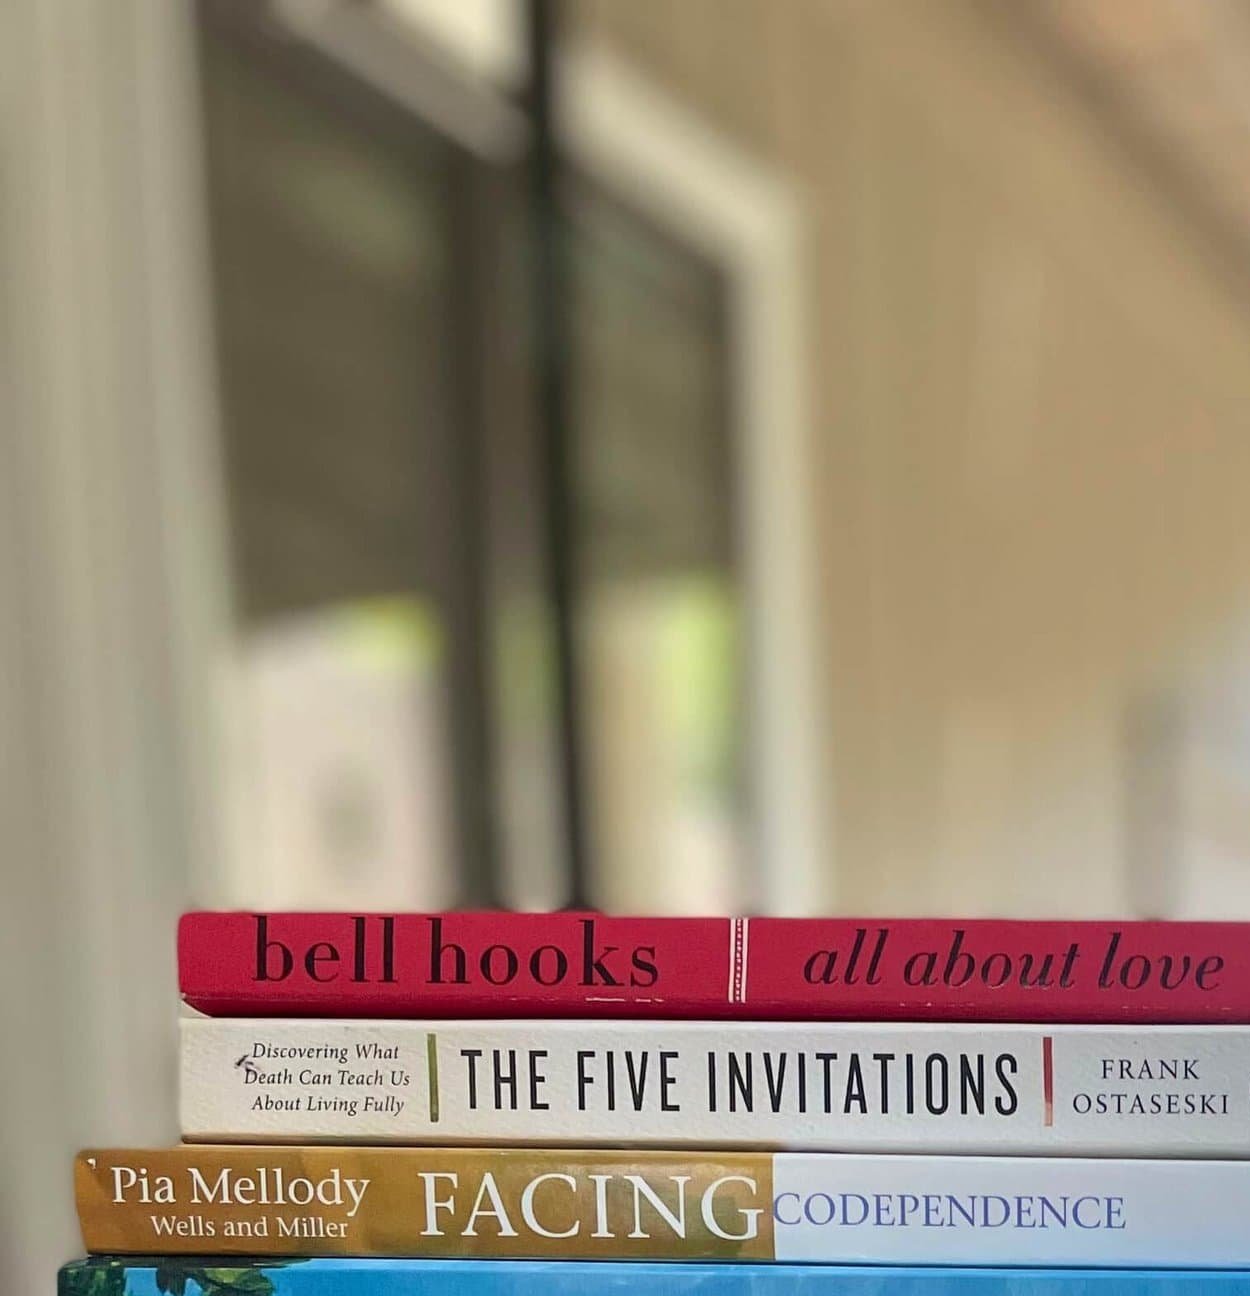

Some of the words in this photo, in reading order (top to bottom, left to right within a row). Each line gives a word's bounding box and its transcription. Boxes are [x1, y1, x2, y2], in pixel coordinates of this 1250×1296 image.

[252, 915, 397, 984] bell
[427, 918, 660, 988] hooks
[804, 929, 888, 987] all
[903, 931, 1081, 990] about
[1098, 931, 1224, 992] love
[252, 1043, 349, 1063] Discovering
[355, 1044, 399, 1060] What
[244, 1069, 293, 1086] Death
[300, 1070, 332, 1086] Can
[338, 1070, 384, 1086] Teach
[390, 1070, 410, 1087] Us
[1101, 1059, 1200, 1081] FRANK
[460, 1049, 550, 1111] THE
[577, 1050, 680, 1111] FIVE
[709, 1051, 1018, 1116] INVITATIONS
[252, 1095, 300, 1113] About
[306, 1096, 358, 1116] Living
[363, 1096, 405, 1117] Fully
[1073, 1092, 1229, 1116] OSTASESKI
[111, 1167, 176, 1204] Pia
[188, 1168, 370, 1216] Mellody
[418, 1172, 763, 1240] FACING
[772, 1193, 1125, 1231] CODEPENDENCE
[151, 1215, 216, 1237] Wells
[223, 1215, 269, 1238] and
[276, 1216, 348, 1239] Miller
